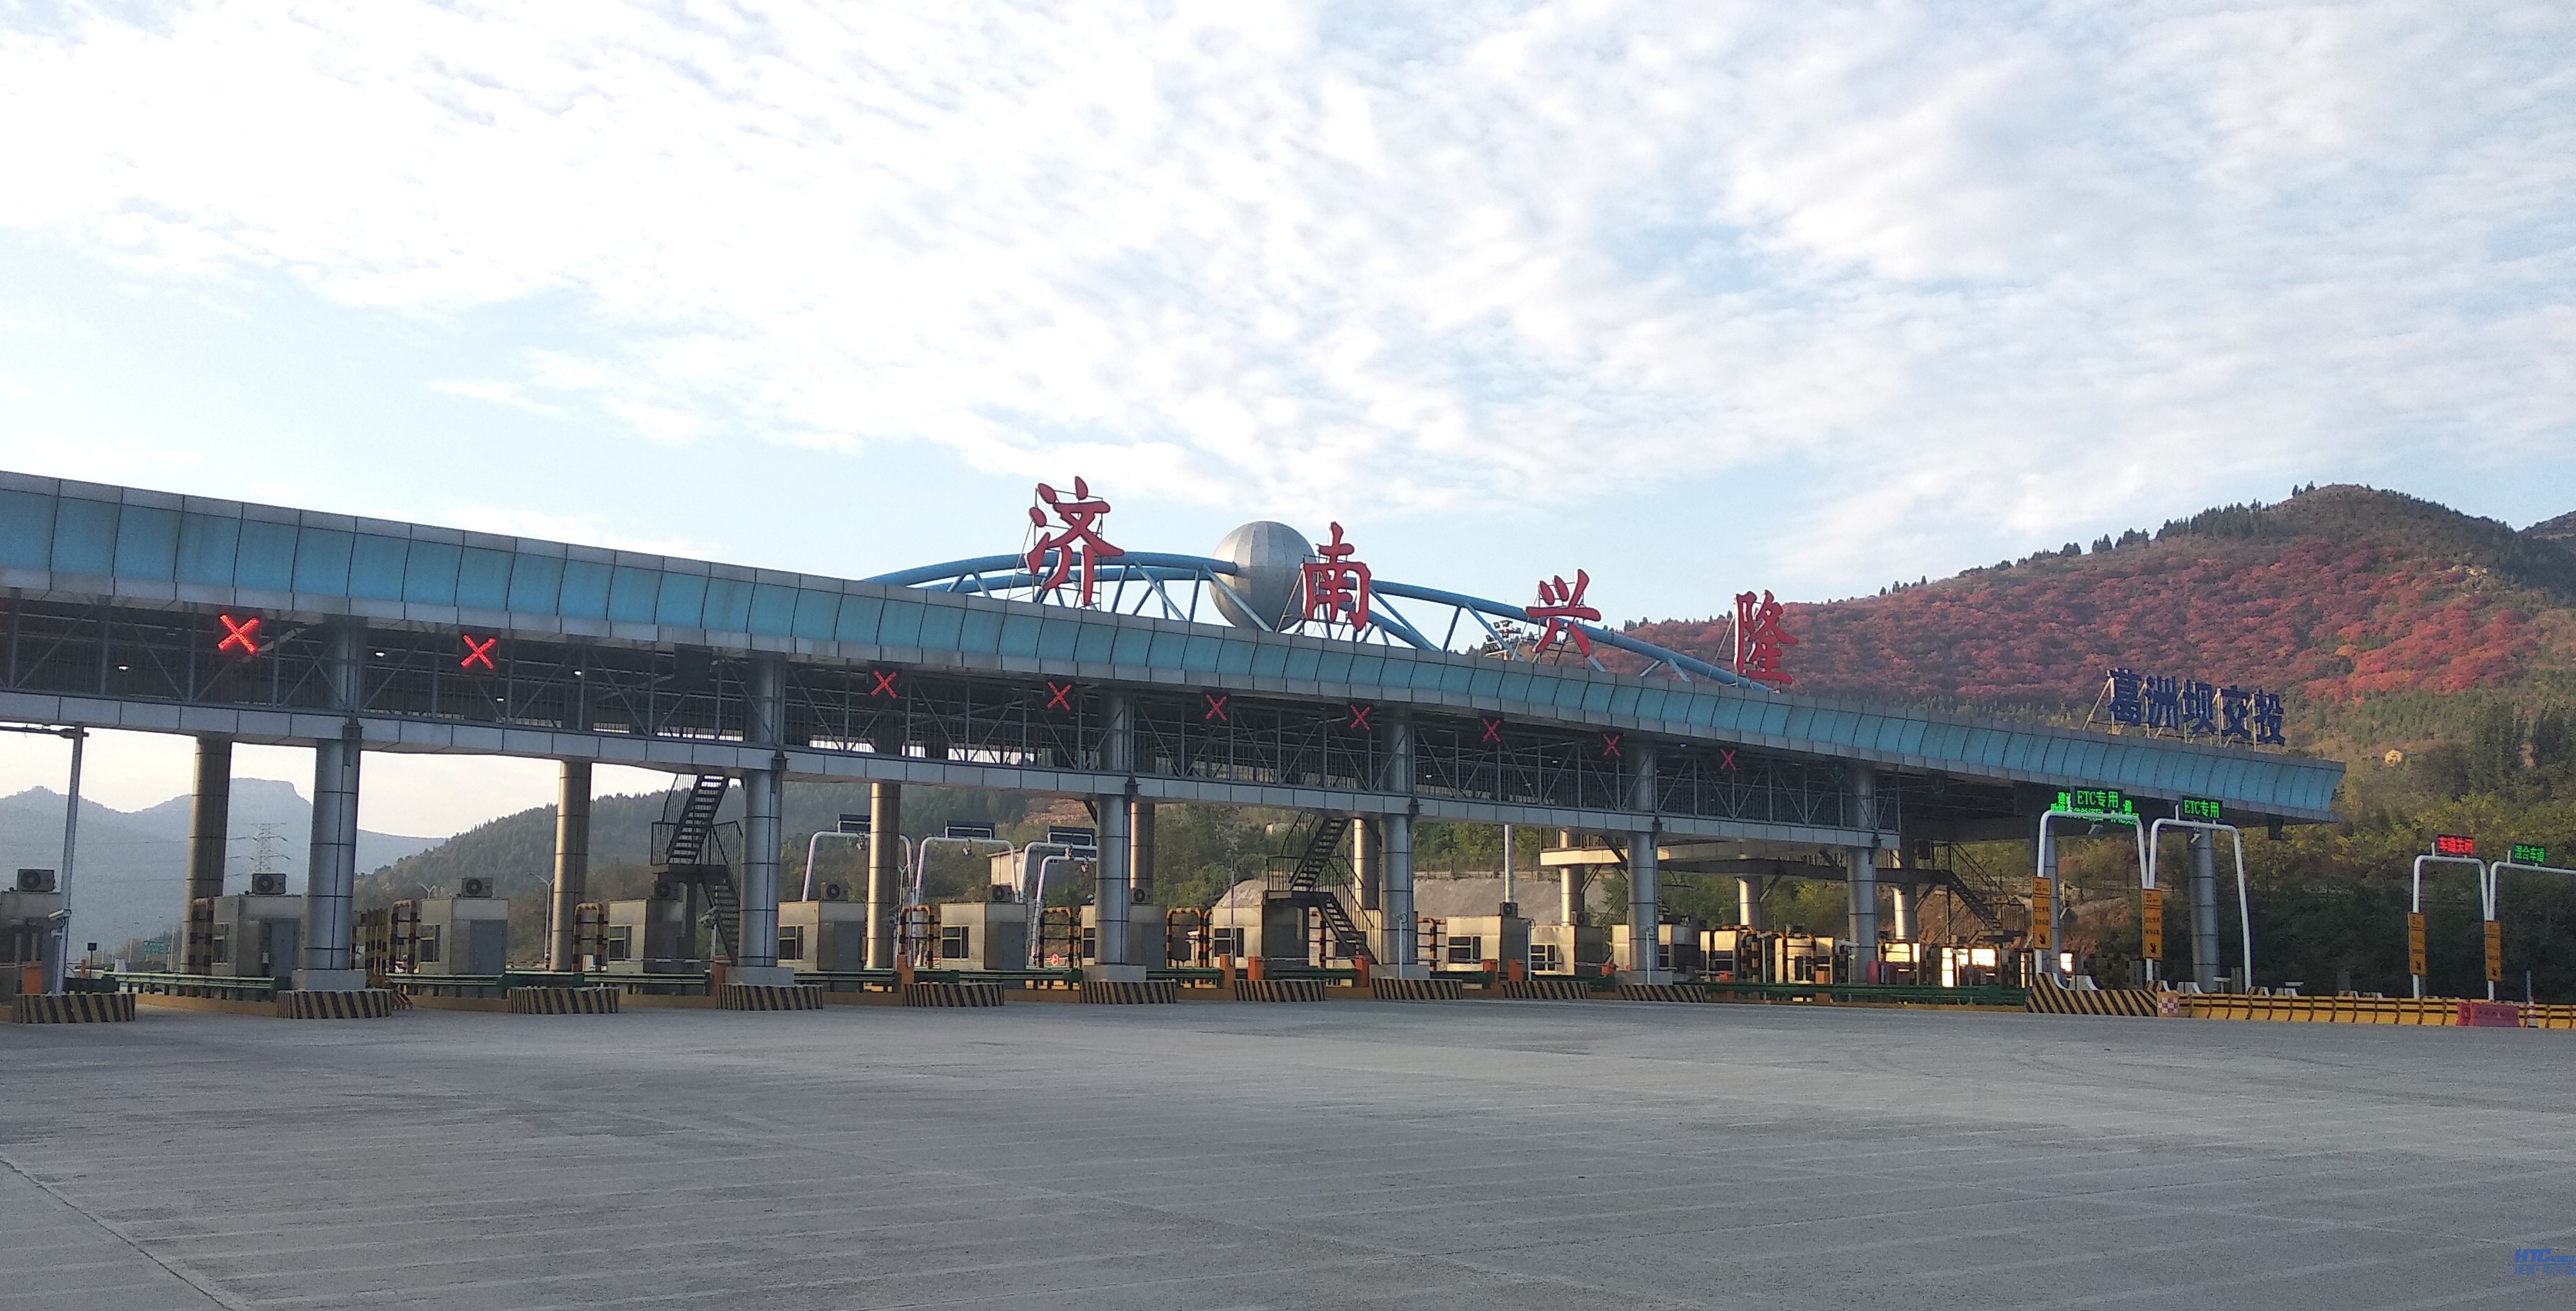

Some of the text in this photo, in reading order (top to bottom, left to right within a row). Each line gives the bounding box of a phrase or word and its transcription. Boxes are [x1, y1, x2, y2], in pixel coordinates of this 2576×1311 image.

[1026, 476, 1798, 685] 济南兴隆
[2107, 668, 2286, 746] 葛洲坝交投
[2077, 790, 2119, 808] ETC专用
[2184, 799, 2220, 818] ETC专用
[2438, 836, 2474, 854] 车道关闭
[2514, 845, 2545, 863] 混合车道
